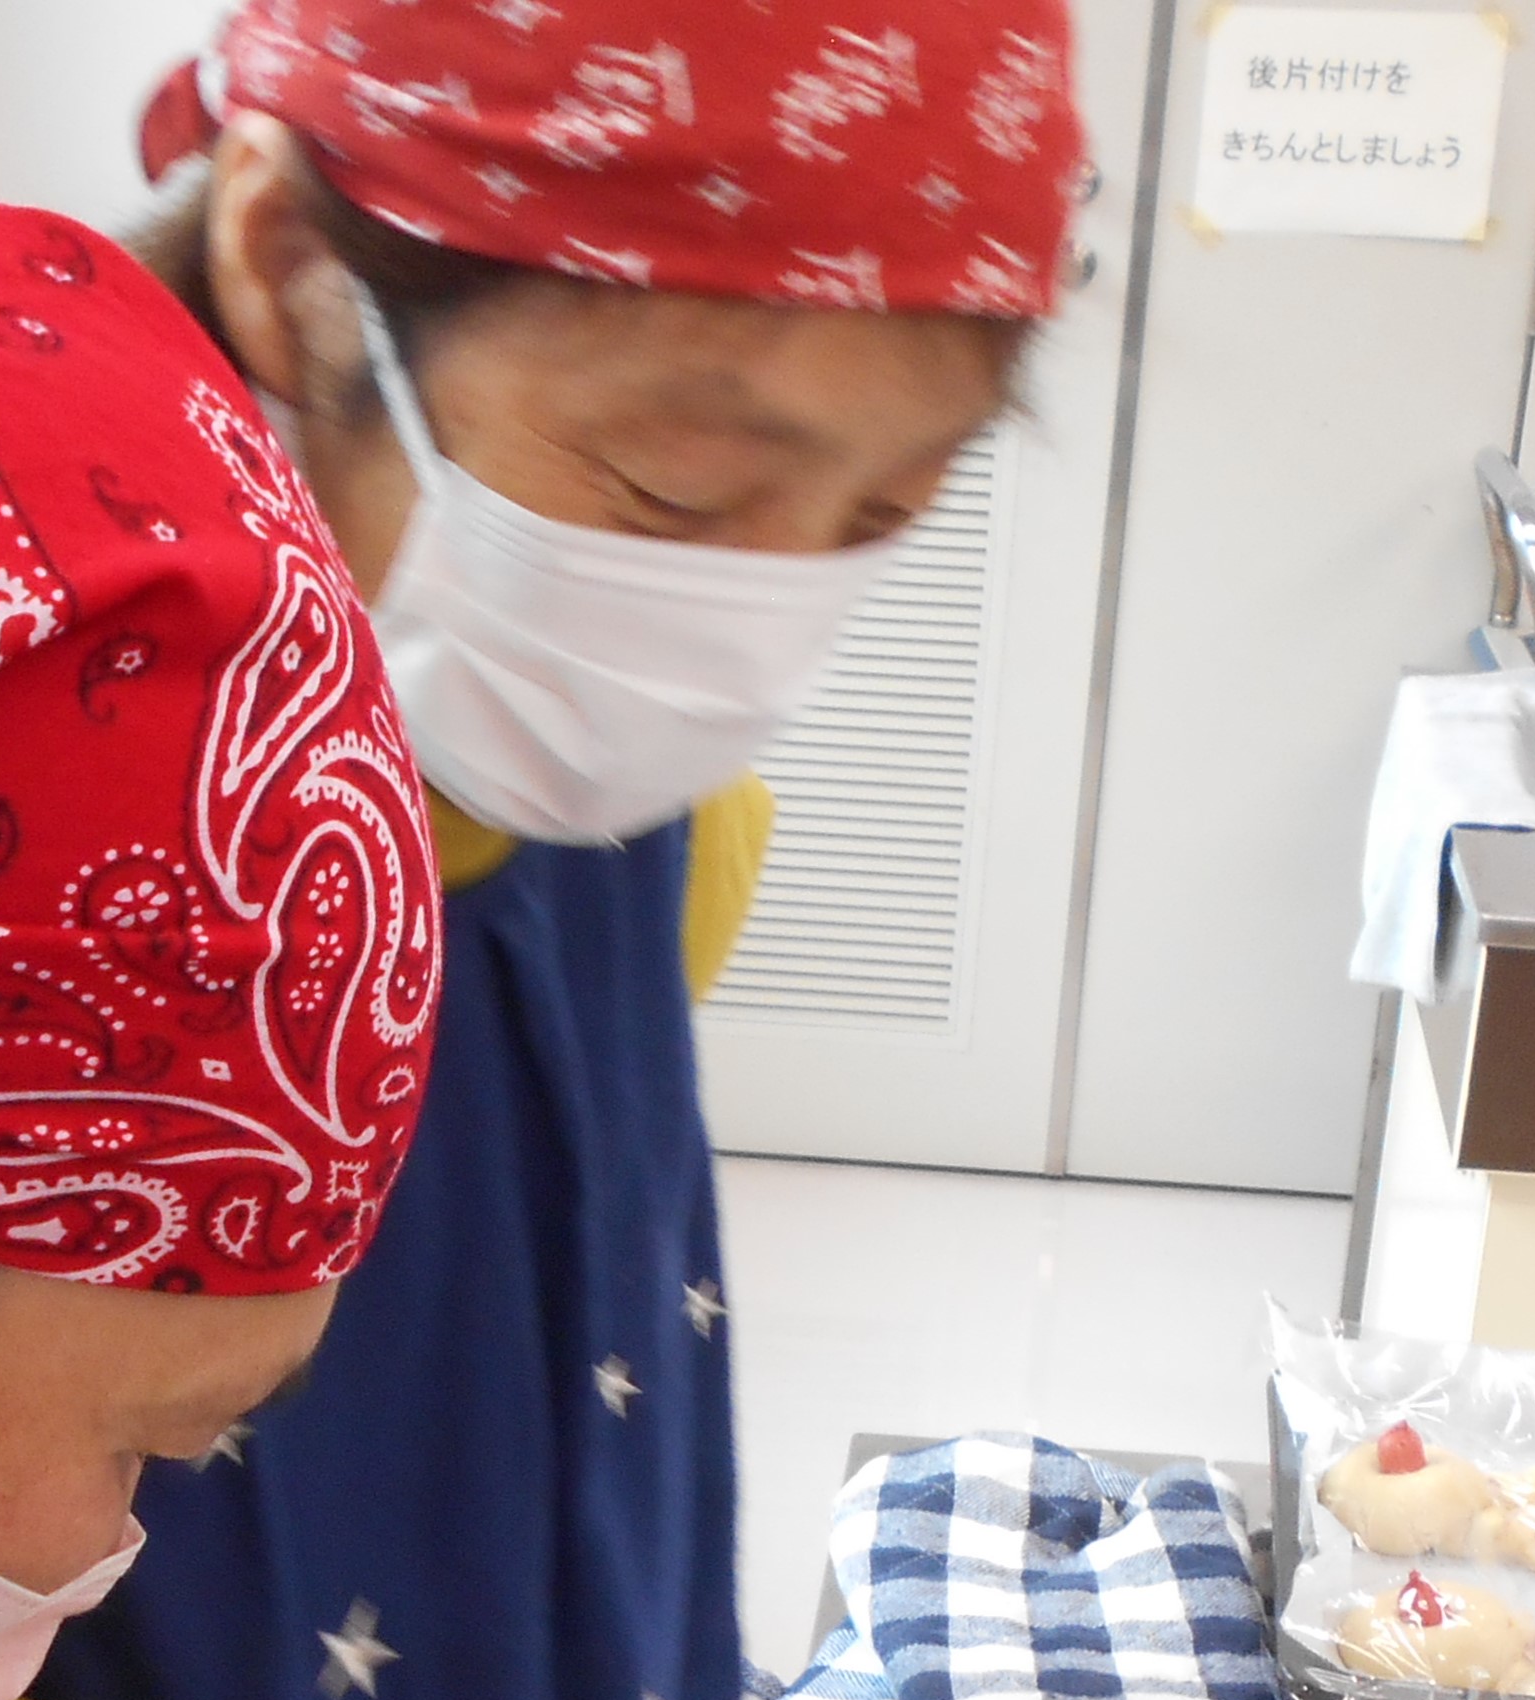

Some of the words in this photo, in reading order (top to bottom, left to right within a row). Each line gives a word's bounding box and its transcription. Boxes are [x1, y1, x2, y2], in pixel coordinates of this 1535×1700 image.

[1247, 56, 1413, 95] 後片付けを
[1222, 130, 1462, 169] きちんとしましょう
